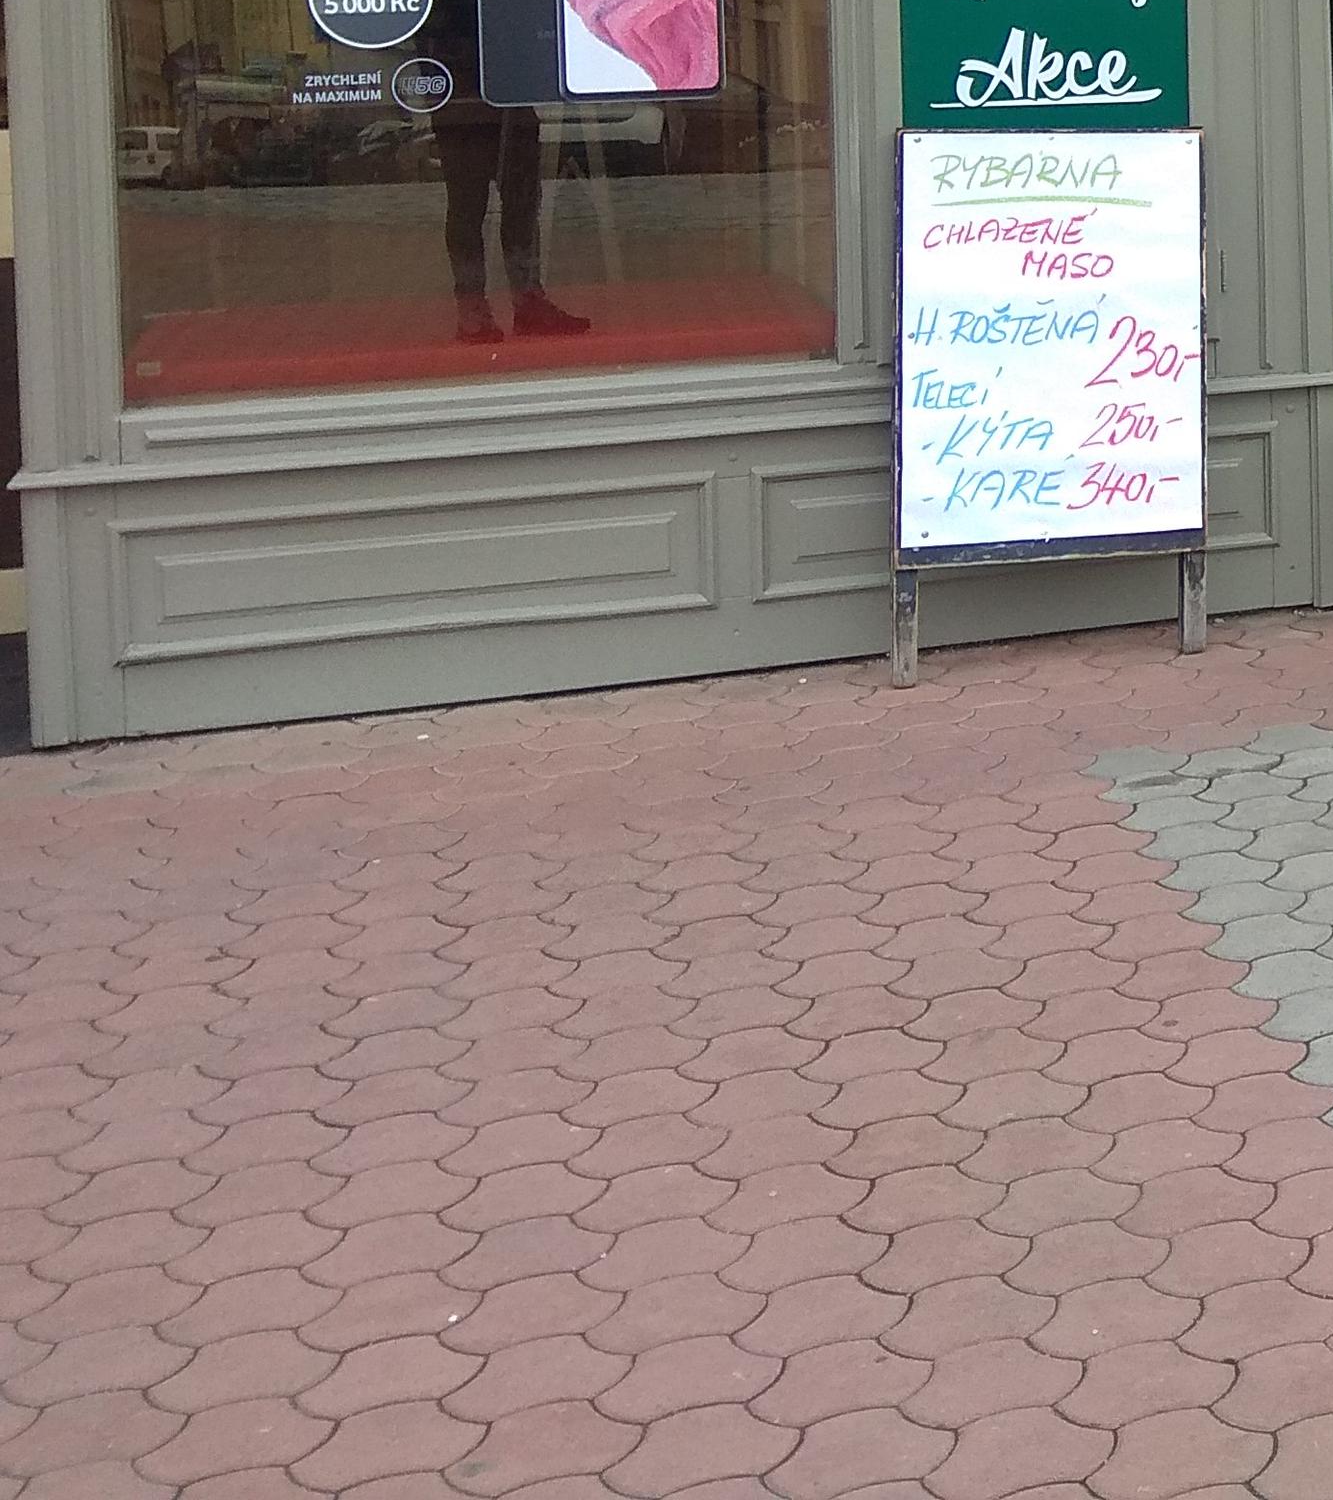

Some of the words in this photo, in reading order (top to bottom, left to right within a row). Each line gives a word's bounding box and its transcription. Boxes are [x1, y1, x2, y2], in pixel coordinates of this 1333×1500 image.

[304, 71, 382, 87] ZRYCHLENÍ
[955, 27, 1138, 108] Akce
[292, 92, 312, 104] NA
[315, 89, 382, 103] MAXIMUM
[930, 150, 1123, 193] RYBÁRNA
[923, 207, 1099, 250] CHLAZENÉ
[1021, 251, 1115, 279] MASO
[912, 366, 1003, 409] TELECÍ
